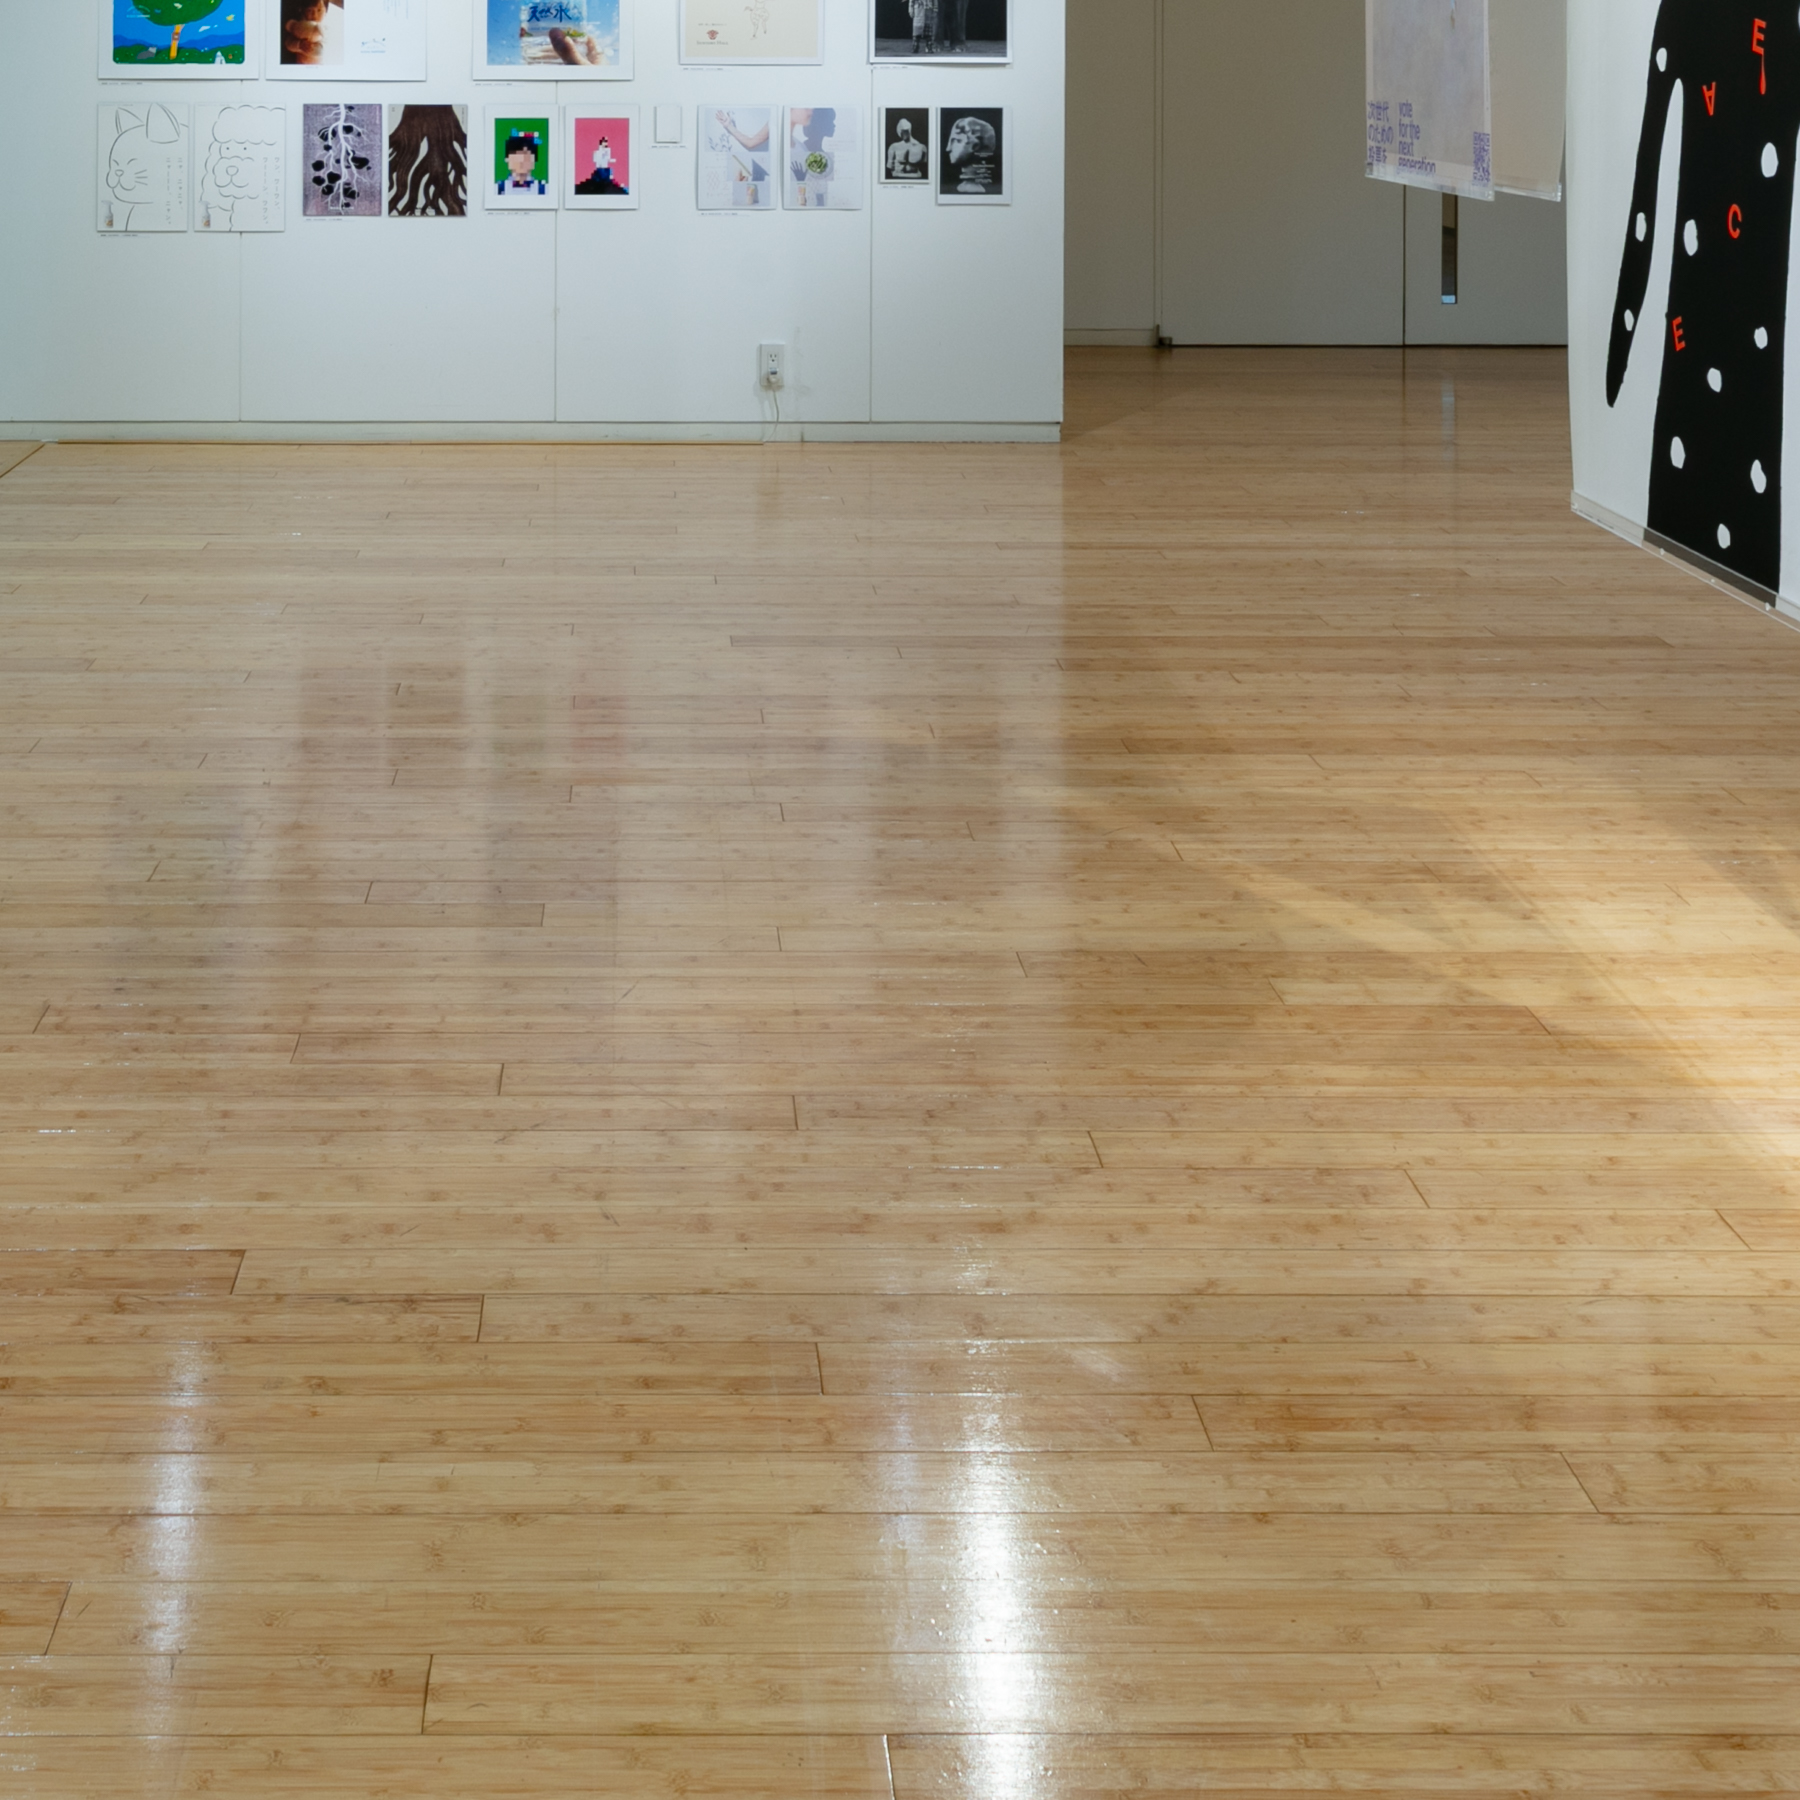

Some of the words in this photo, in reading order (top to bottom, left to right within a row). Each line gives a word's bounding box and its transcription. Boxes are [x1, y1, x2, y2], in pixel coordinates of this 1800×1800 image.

[527, 4, 572, 23] 天然水
[1752, 18, 1767, 55] E
[1399, 100, 1413, 118] vote
[1702, 81, 1716, 116] A
[1367, 100, 1390, 122] 次世代
[1368, 124, 1394, 145] のための
[1399, 118, 1409, 138] for
[1409, 120, 1421, 140] the
[1399, 141, 1414, 157] next
[1727, 203, 1742, 239] C
[1672, 316, 1686, 351] E
